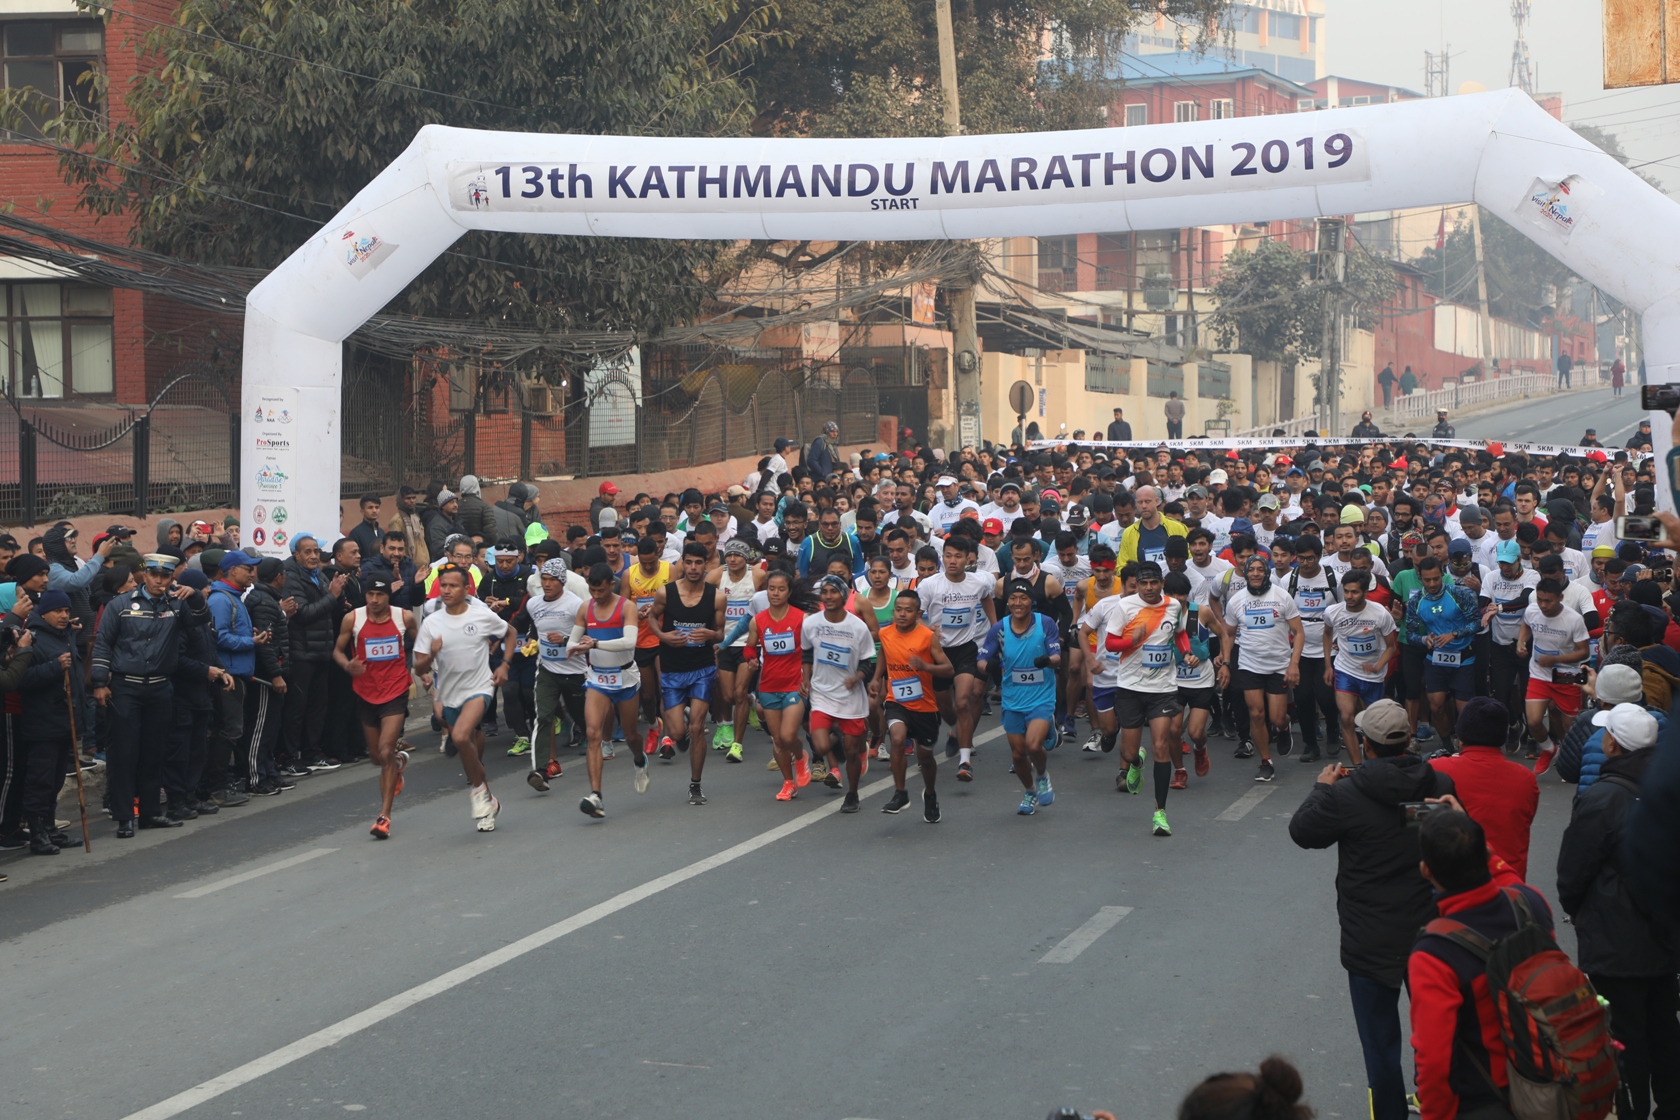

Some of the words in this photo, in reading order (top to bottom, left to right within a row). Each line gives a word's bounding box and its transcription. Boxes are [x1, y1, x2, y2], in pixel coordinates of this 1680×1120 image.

[494, 163, 593, 199] 13th
[608, 161, 915, 199] KATHMANDU
[930, 143, 1214, 195] MARATHON
[1231, 133, 1354, 177] 2019
[871, 198, 919, 210] START
[1549, 206, 1570, 224] Nepal
[256, 438, 290, 447] ProSports
[1304, 598, 1322, 607] 587
[726, 608, 745, 616] 610
[950, 615, 963, 624] 75
[1253, 616, 1266, 625] 78
[772, 640, 787, 650] 90
[1353, 643, 1372, 652] 118
[371, 645, 394, 656] 612
[546, 647, 559, 656] 80
[827, 651, 841, 662] 82
[1149, 653, 1168, 662] 102
[1437, 653, 1456, 663] 120
[598, 675, 617, 685] 613
[1020, 673, 1035, 682] 94
[898, 686, 914, 697] 73
